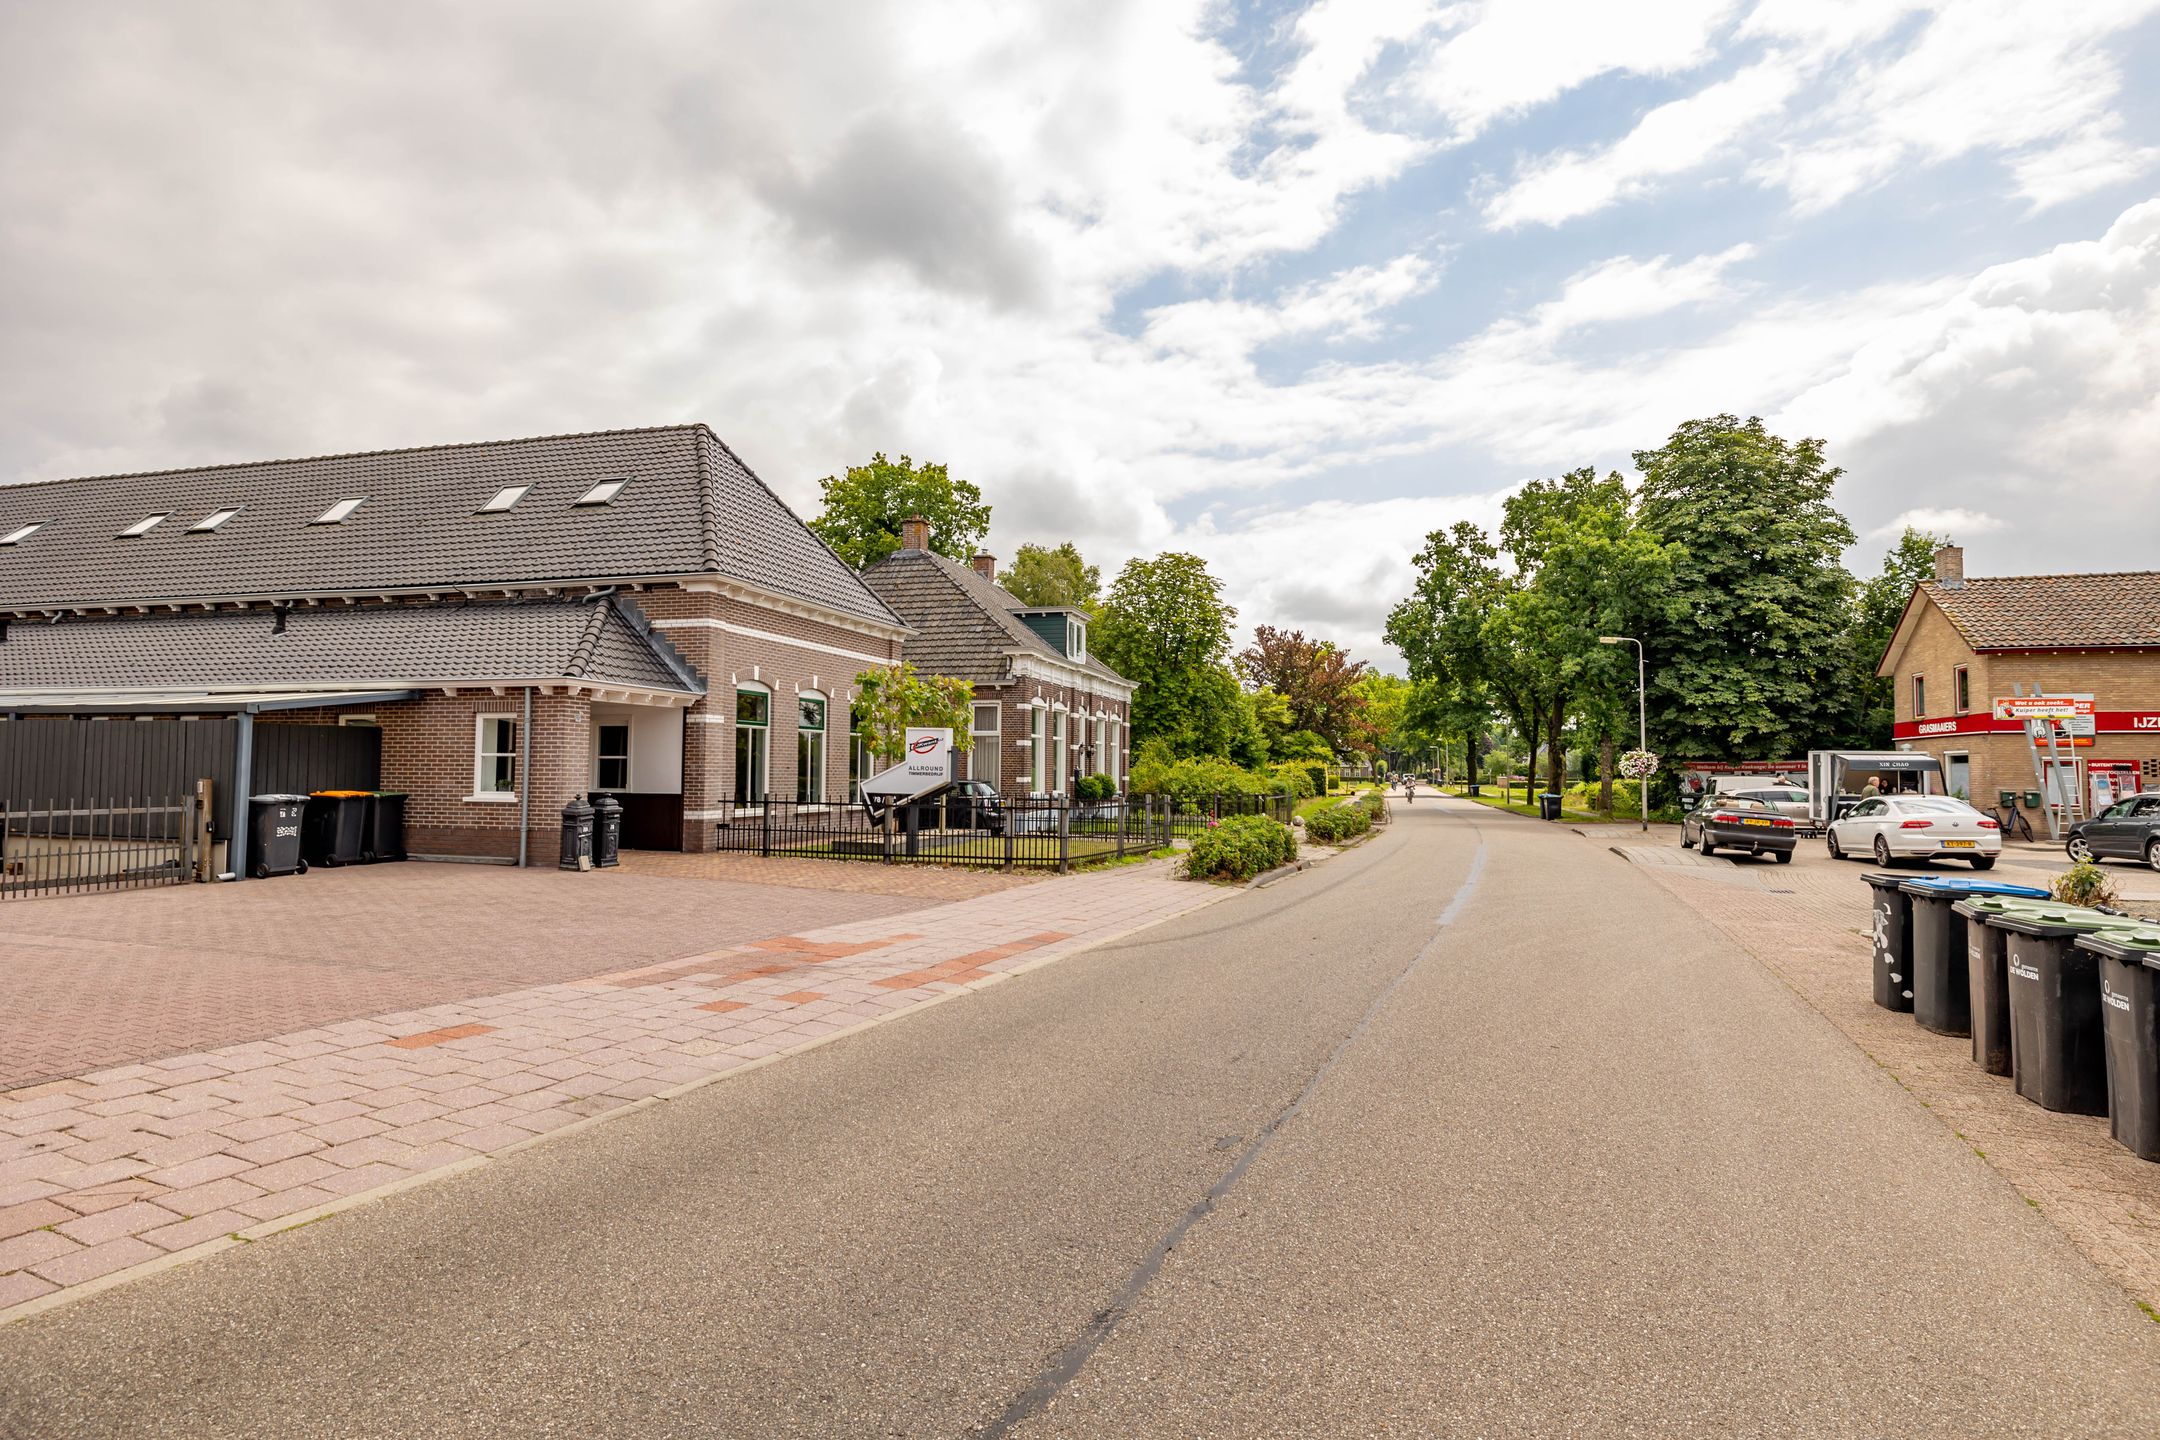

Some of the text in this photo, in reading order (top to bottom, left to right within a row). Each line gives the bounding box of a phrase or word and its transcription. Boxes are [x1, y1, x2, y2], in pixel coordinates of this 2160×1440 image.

[1918, 721, 1957, 734] GRASMAAIERS
[2016, 968, 2039, 981] WOLDEN
[2107, 995, 2130, 1012] WOLDEN
